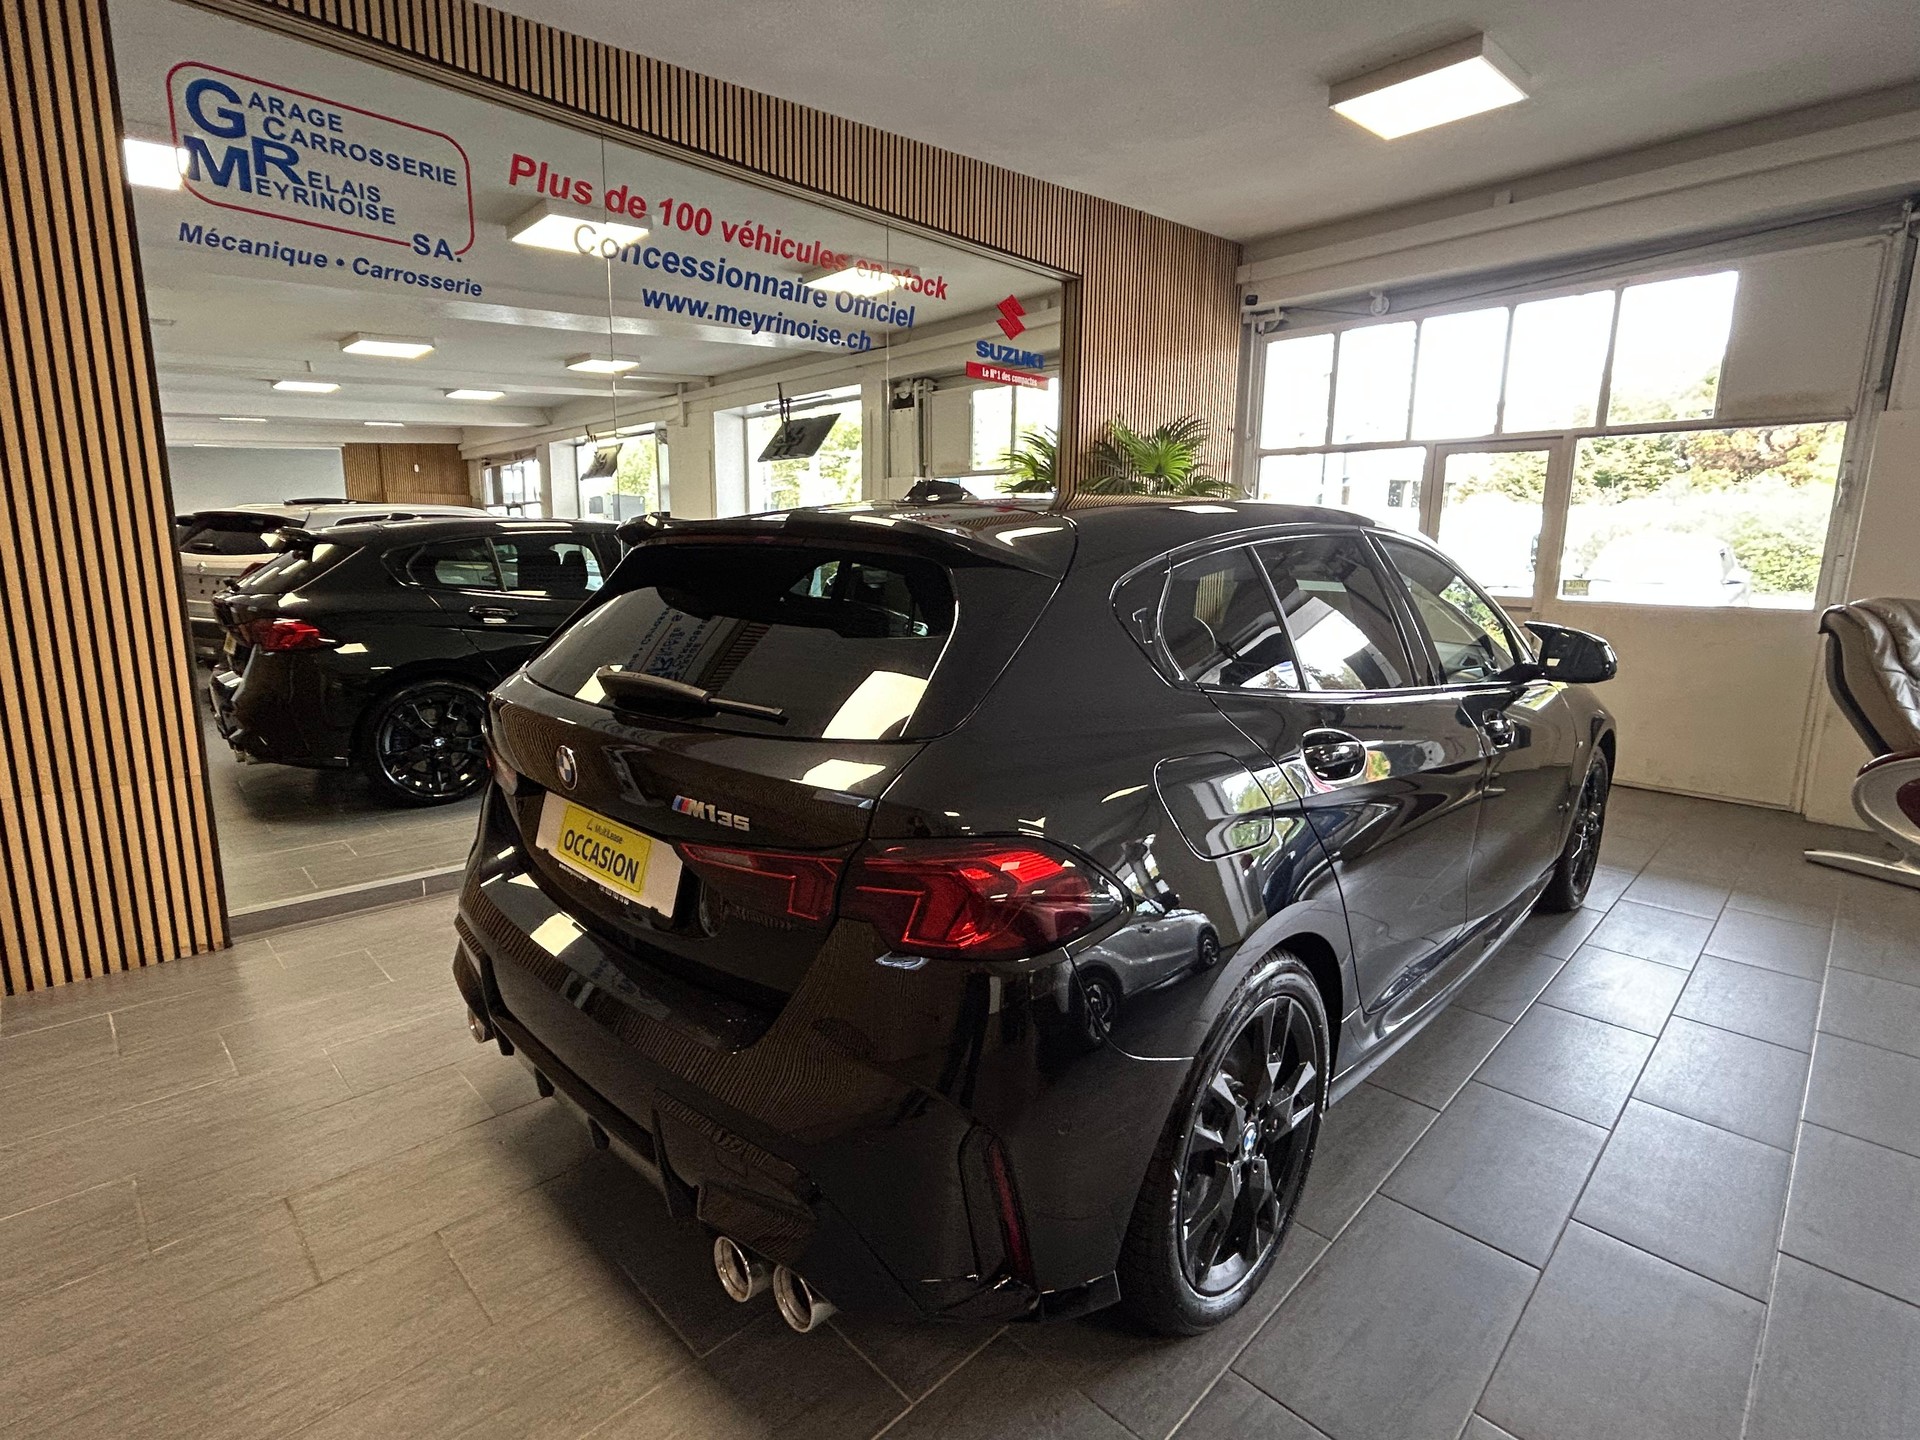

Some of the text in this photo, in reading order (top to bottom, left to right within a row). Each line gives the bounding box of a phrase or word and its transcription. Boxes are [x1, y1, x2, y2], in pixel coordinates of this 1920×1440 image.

[262, 116, 458, 186] CARROSSERIE
[508, 153, 593, 206] Plus
[604, 184, 647, 219] de
[658, 198, 713, 237] 100
[721, 218, 847, 273] véhicules
[178, 222, 483, 297] Mécanique Carrosserie
[412, 234, 463, 262] SA.
[574, 224, 916, 329] Concessionnaire Officiel
[642, 285, 872, 352] www.meyrinoise.ch
[976, 340, 1045, 369] SUZUKI
[982, 367, 989, 377] Le
[1001, 371, 1010, 381] des
[1012, 375, 1037, 386] compactes
[687, 799, 750, 832] M135
[564, 829, 639, 884] OCCASION
